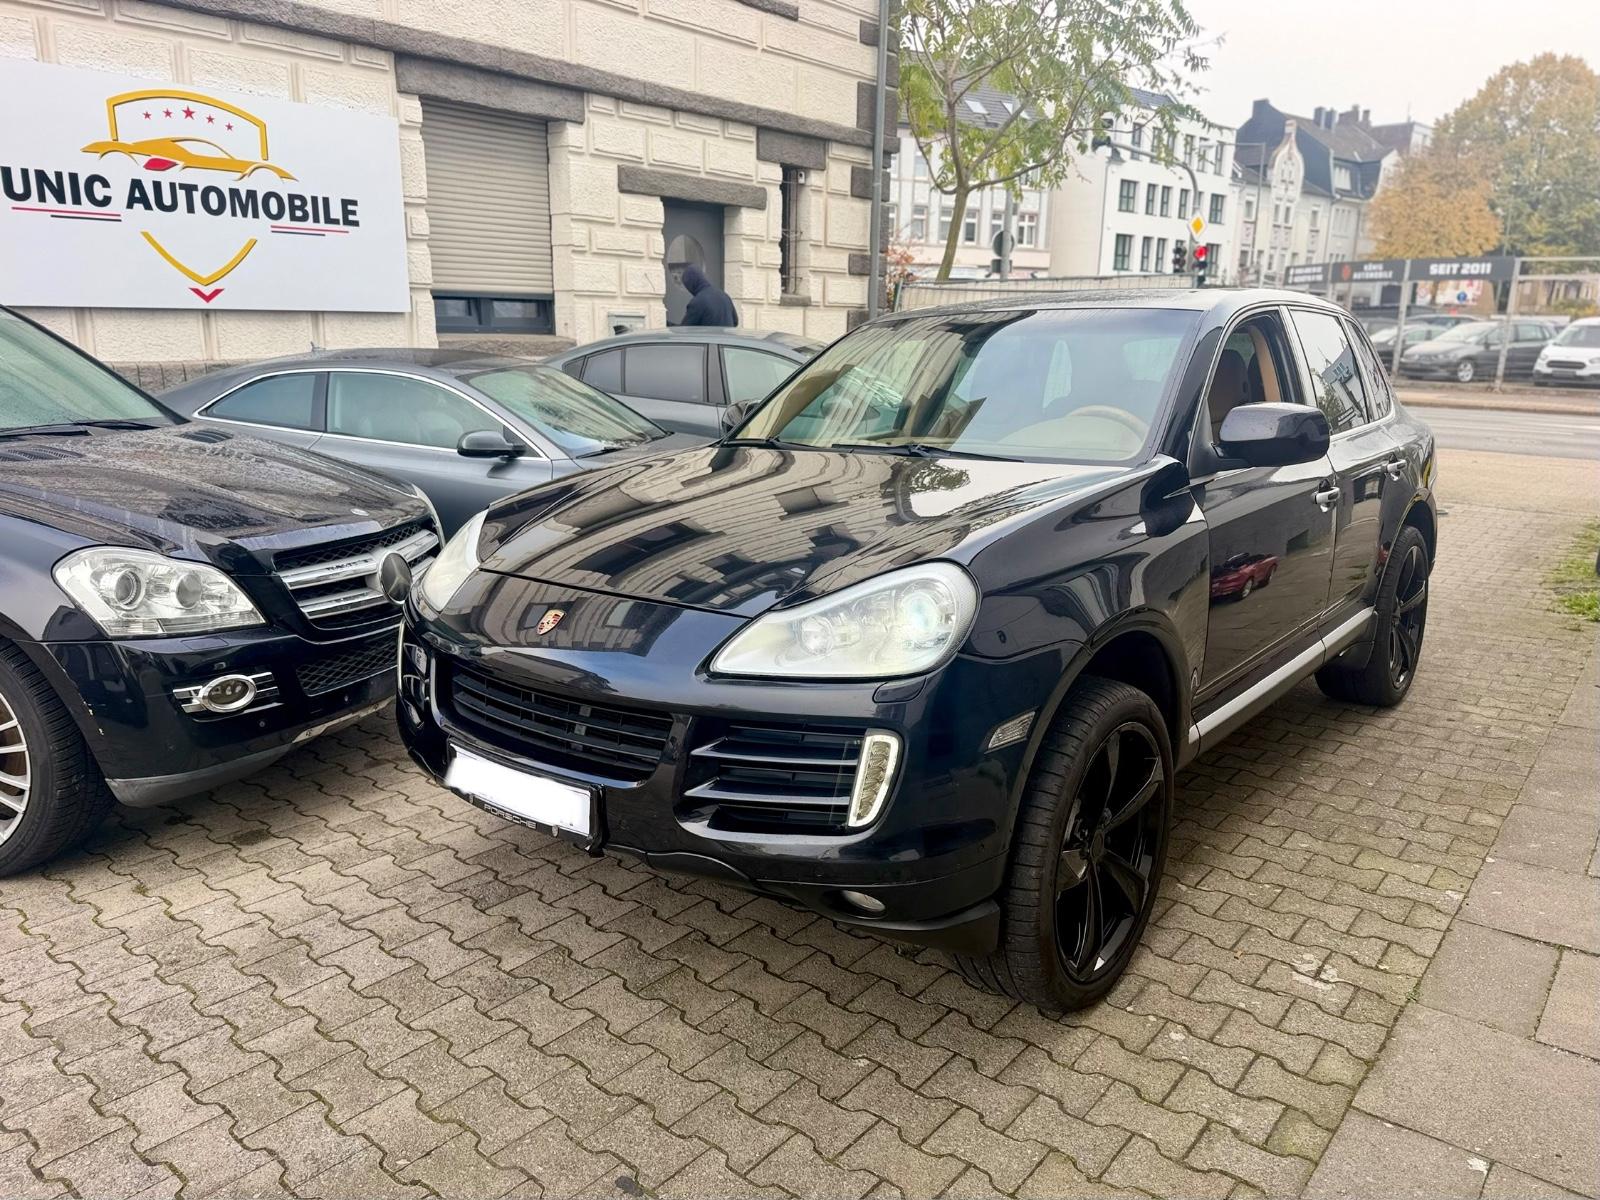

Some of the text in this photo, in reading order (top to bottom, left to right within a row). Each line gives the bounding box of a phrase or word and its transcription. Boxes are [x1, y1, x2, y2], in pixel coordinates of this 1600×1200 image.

[0, 166, 360, 228] UNIC AUTOMOBILE
[1429, 261, 1492, 276] SEIT 2011
[484, 803, 537, 830] PORSCHE
